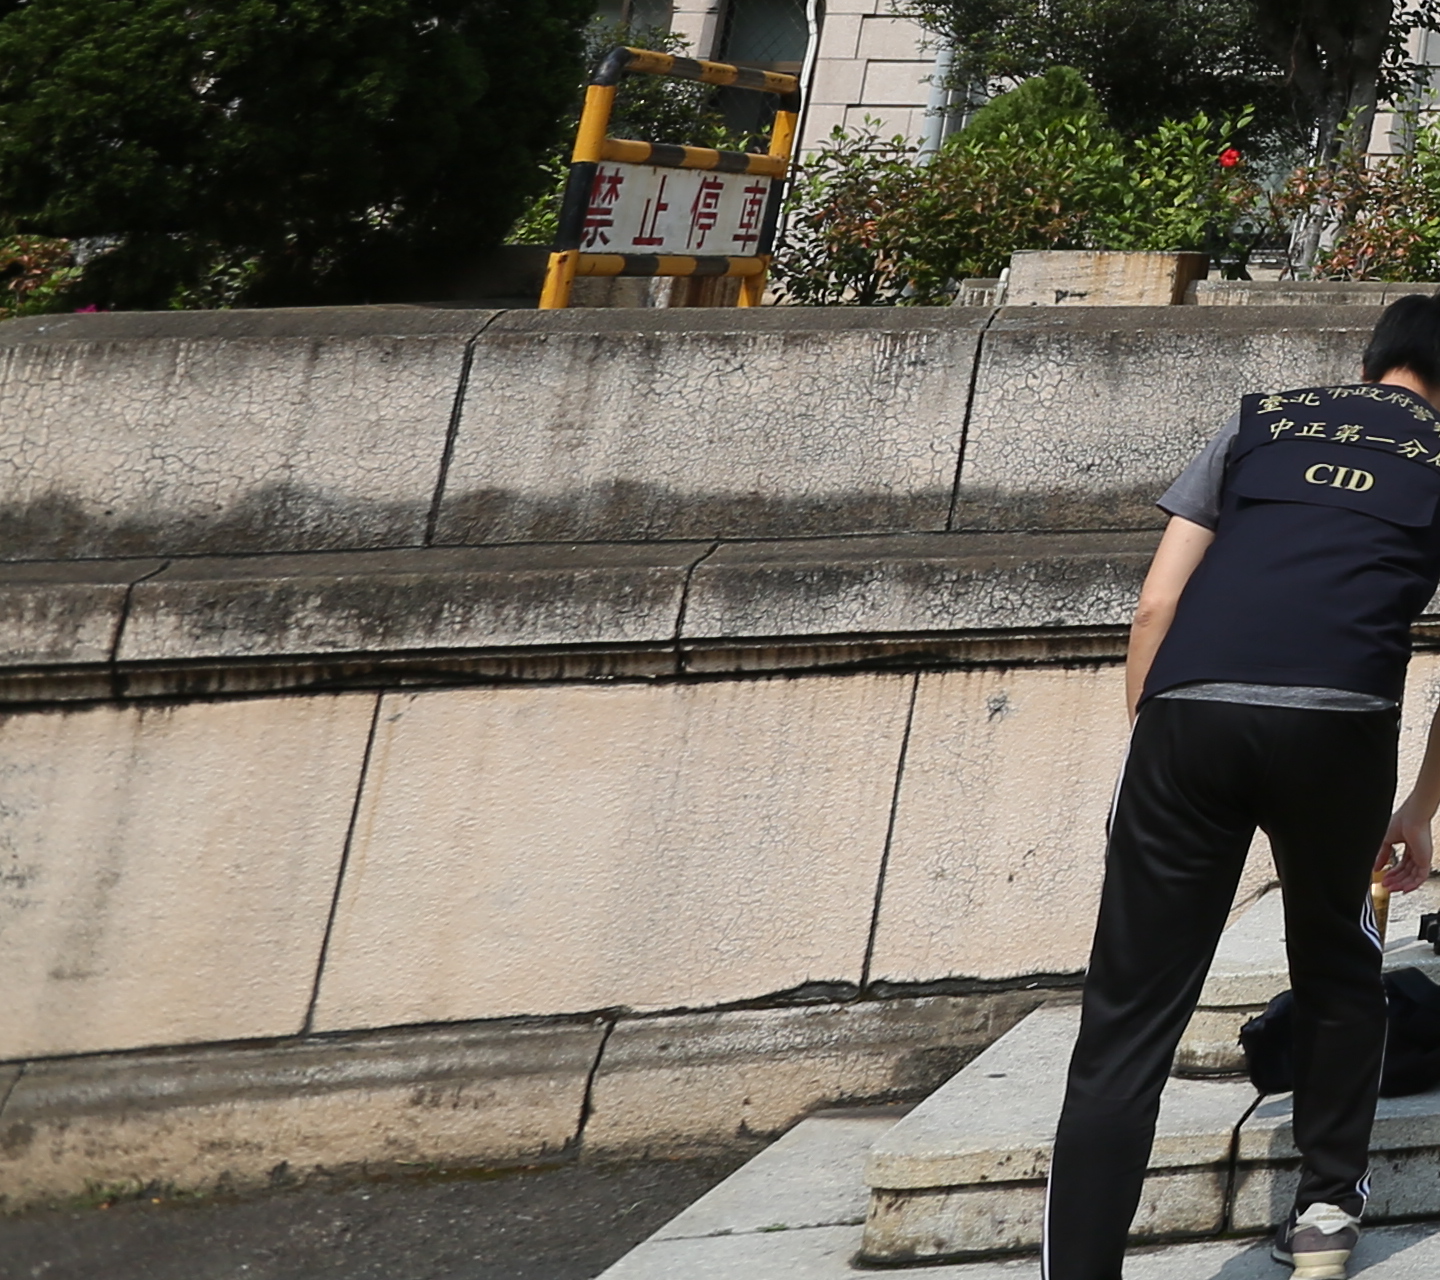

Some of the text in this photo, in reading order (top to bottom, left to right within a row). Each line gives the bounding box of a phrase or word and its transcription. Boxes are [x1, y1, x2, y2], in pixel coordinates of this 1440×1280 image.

[581, 166, 769, 252] 禁止停車
[1304, 463, 1376, 492] CID
